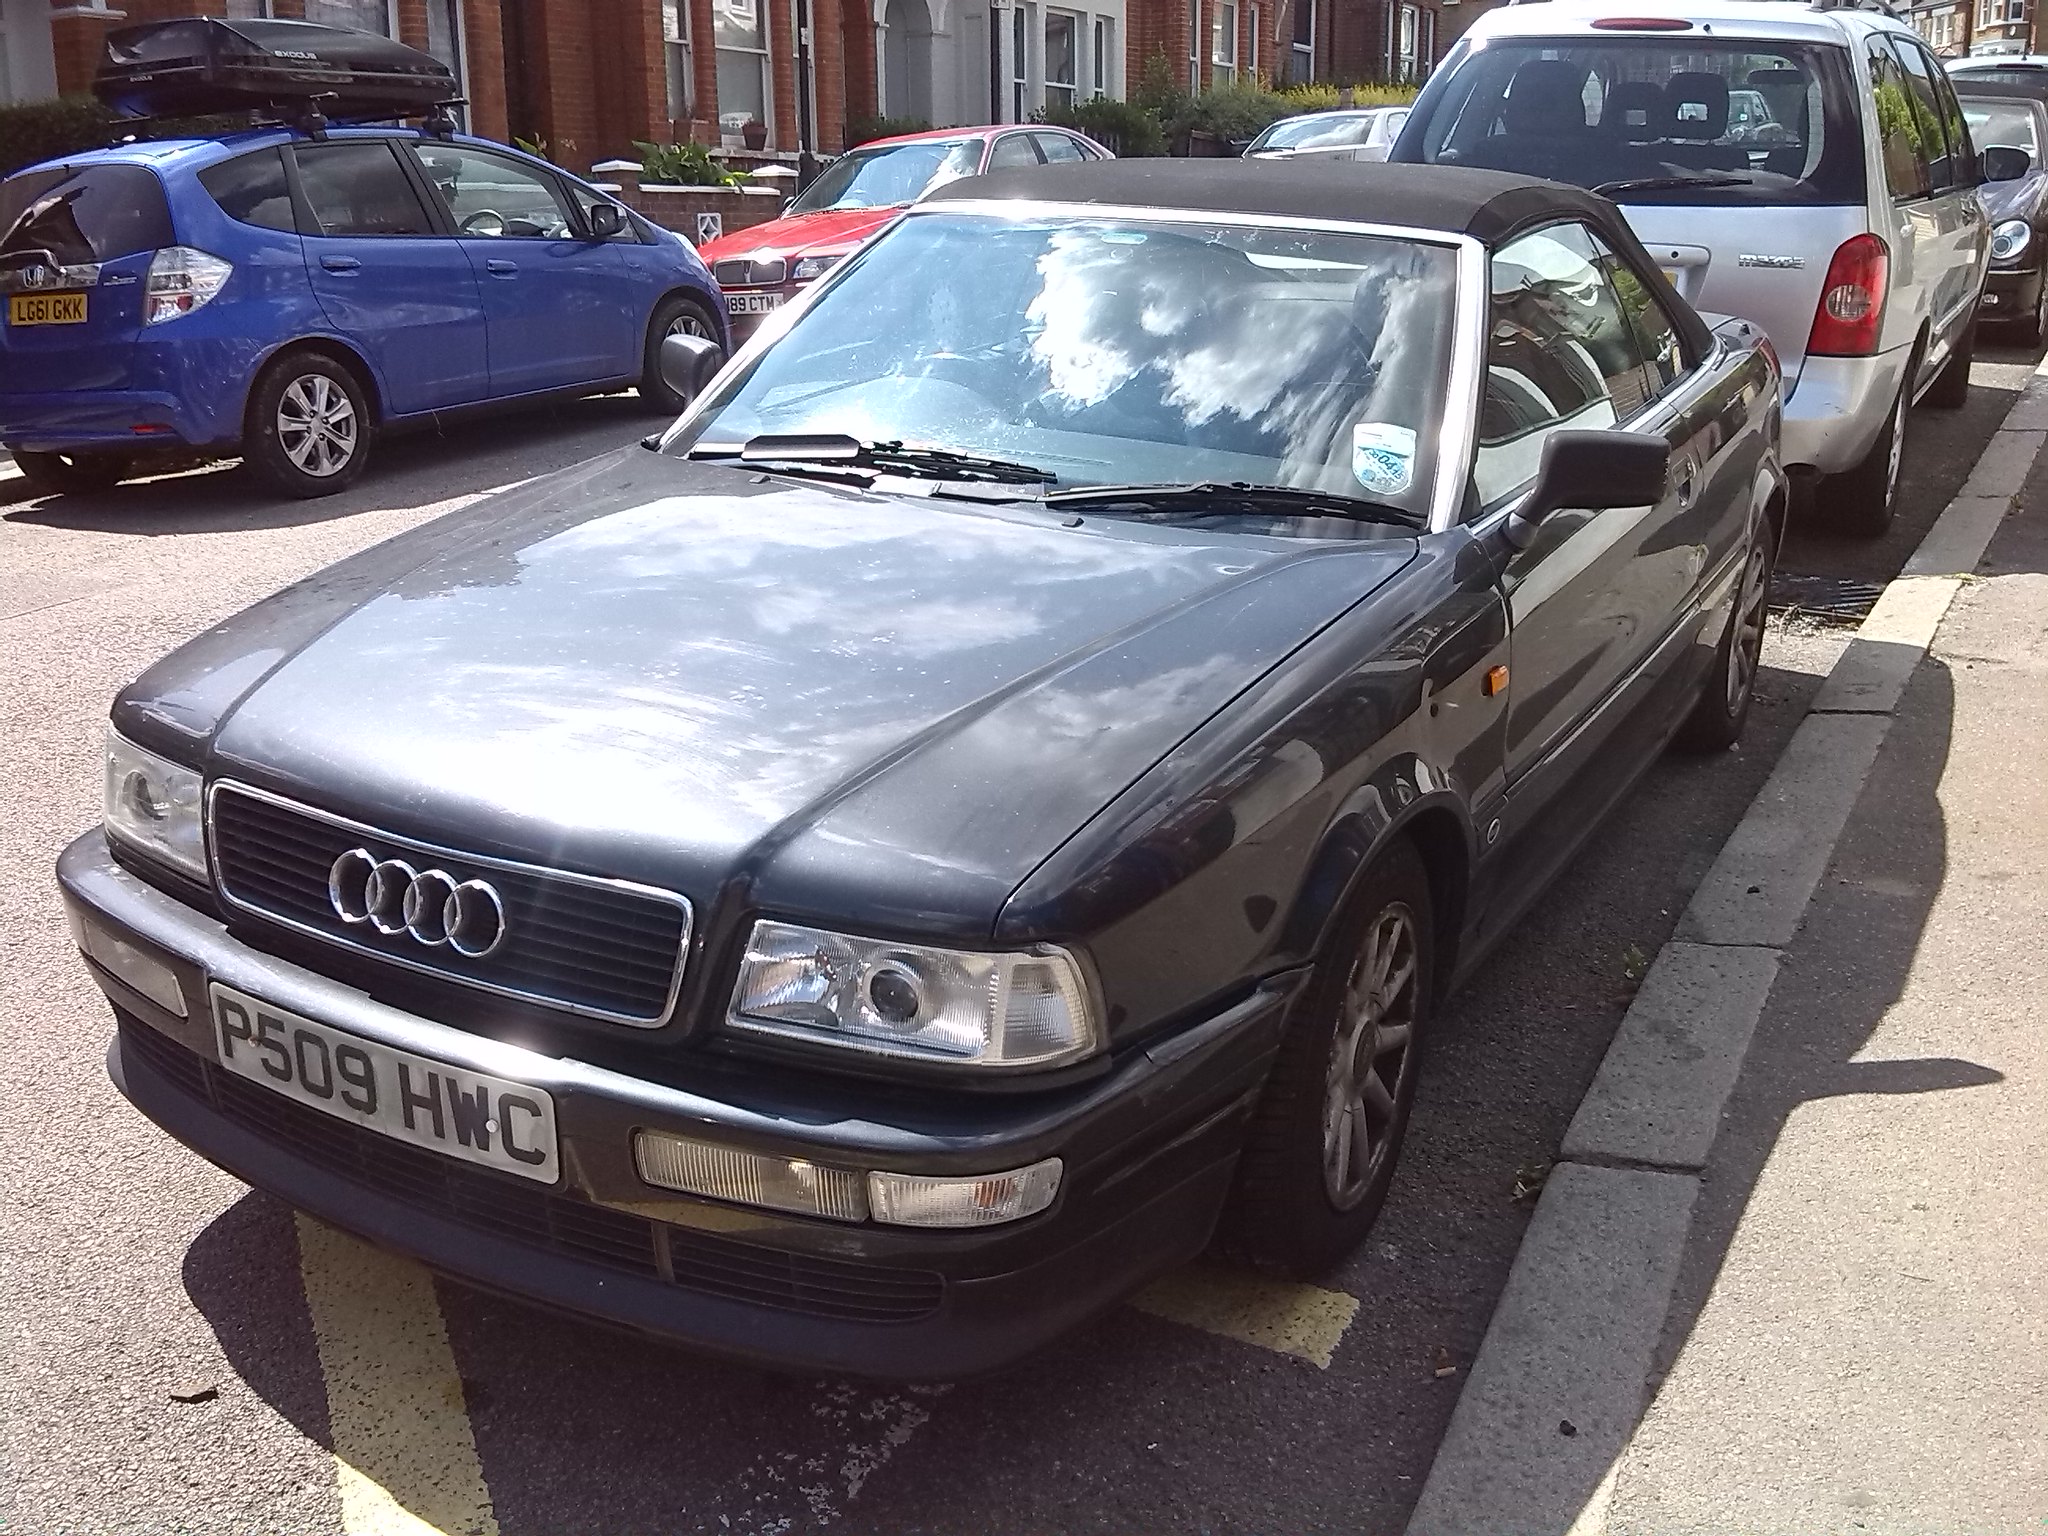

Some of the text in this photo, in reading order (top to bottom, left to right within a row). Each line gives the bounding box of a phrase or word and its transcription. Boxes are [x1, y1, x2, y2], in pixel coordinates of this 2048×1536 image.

[18, 298, 82, 321] LG61 GKK
[749, 296, 774, 312] CTM
[216, 996, 546, 1166] P509 HWC
